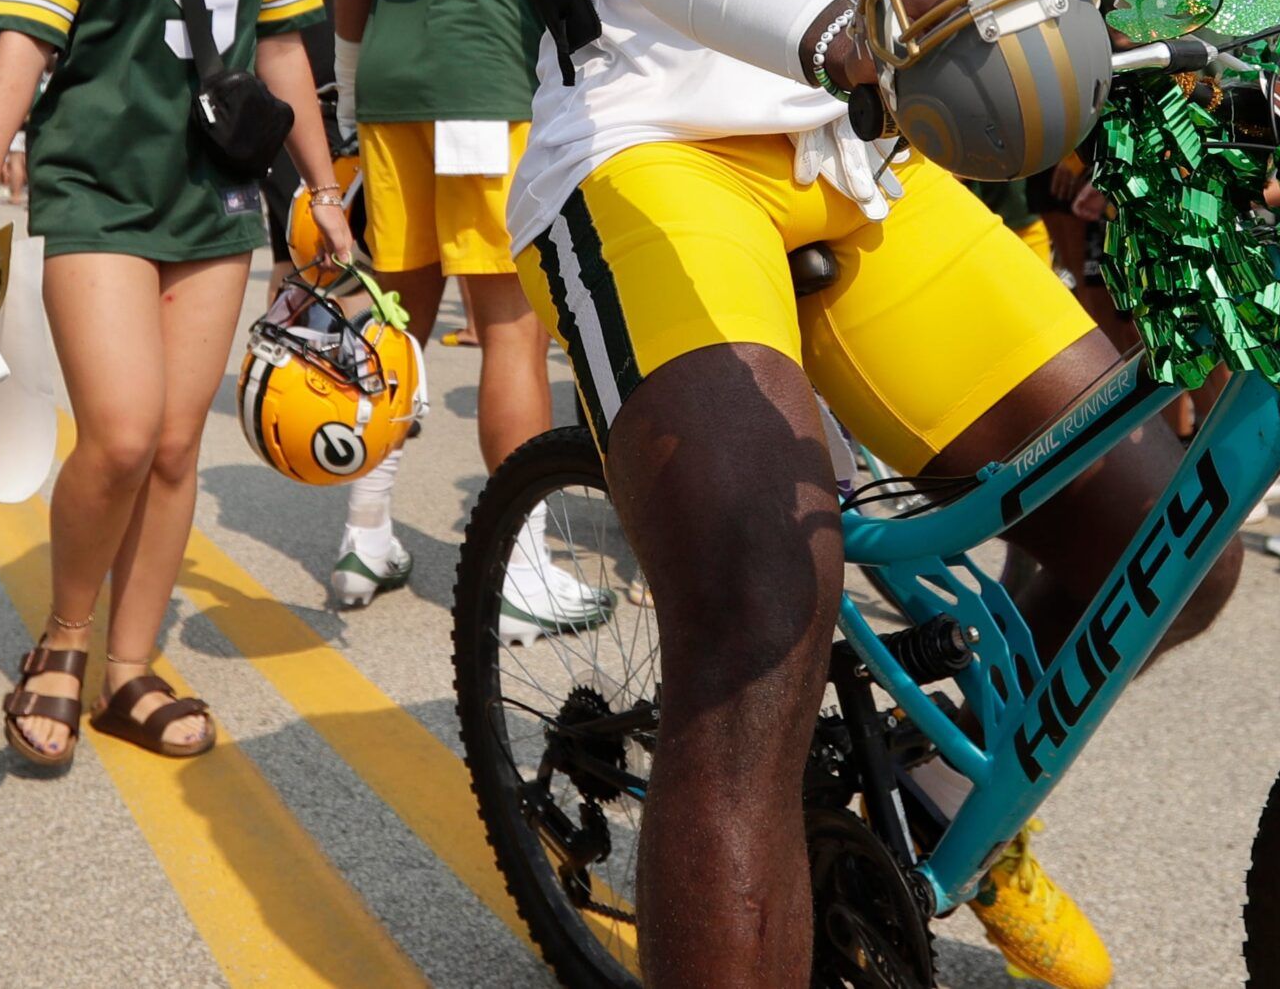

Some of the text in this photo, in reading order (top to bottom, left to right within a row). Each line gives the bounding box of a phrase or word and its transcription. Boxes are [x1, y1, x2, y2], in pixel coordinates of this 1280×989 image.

[1012, 369, 1131, 478] TRAIL RUNNER
[1011, 448, 1230, 783] HUFFY
